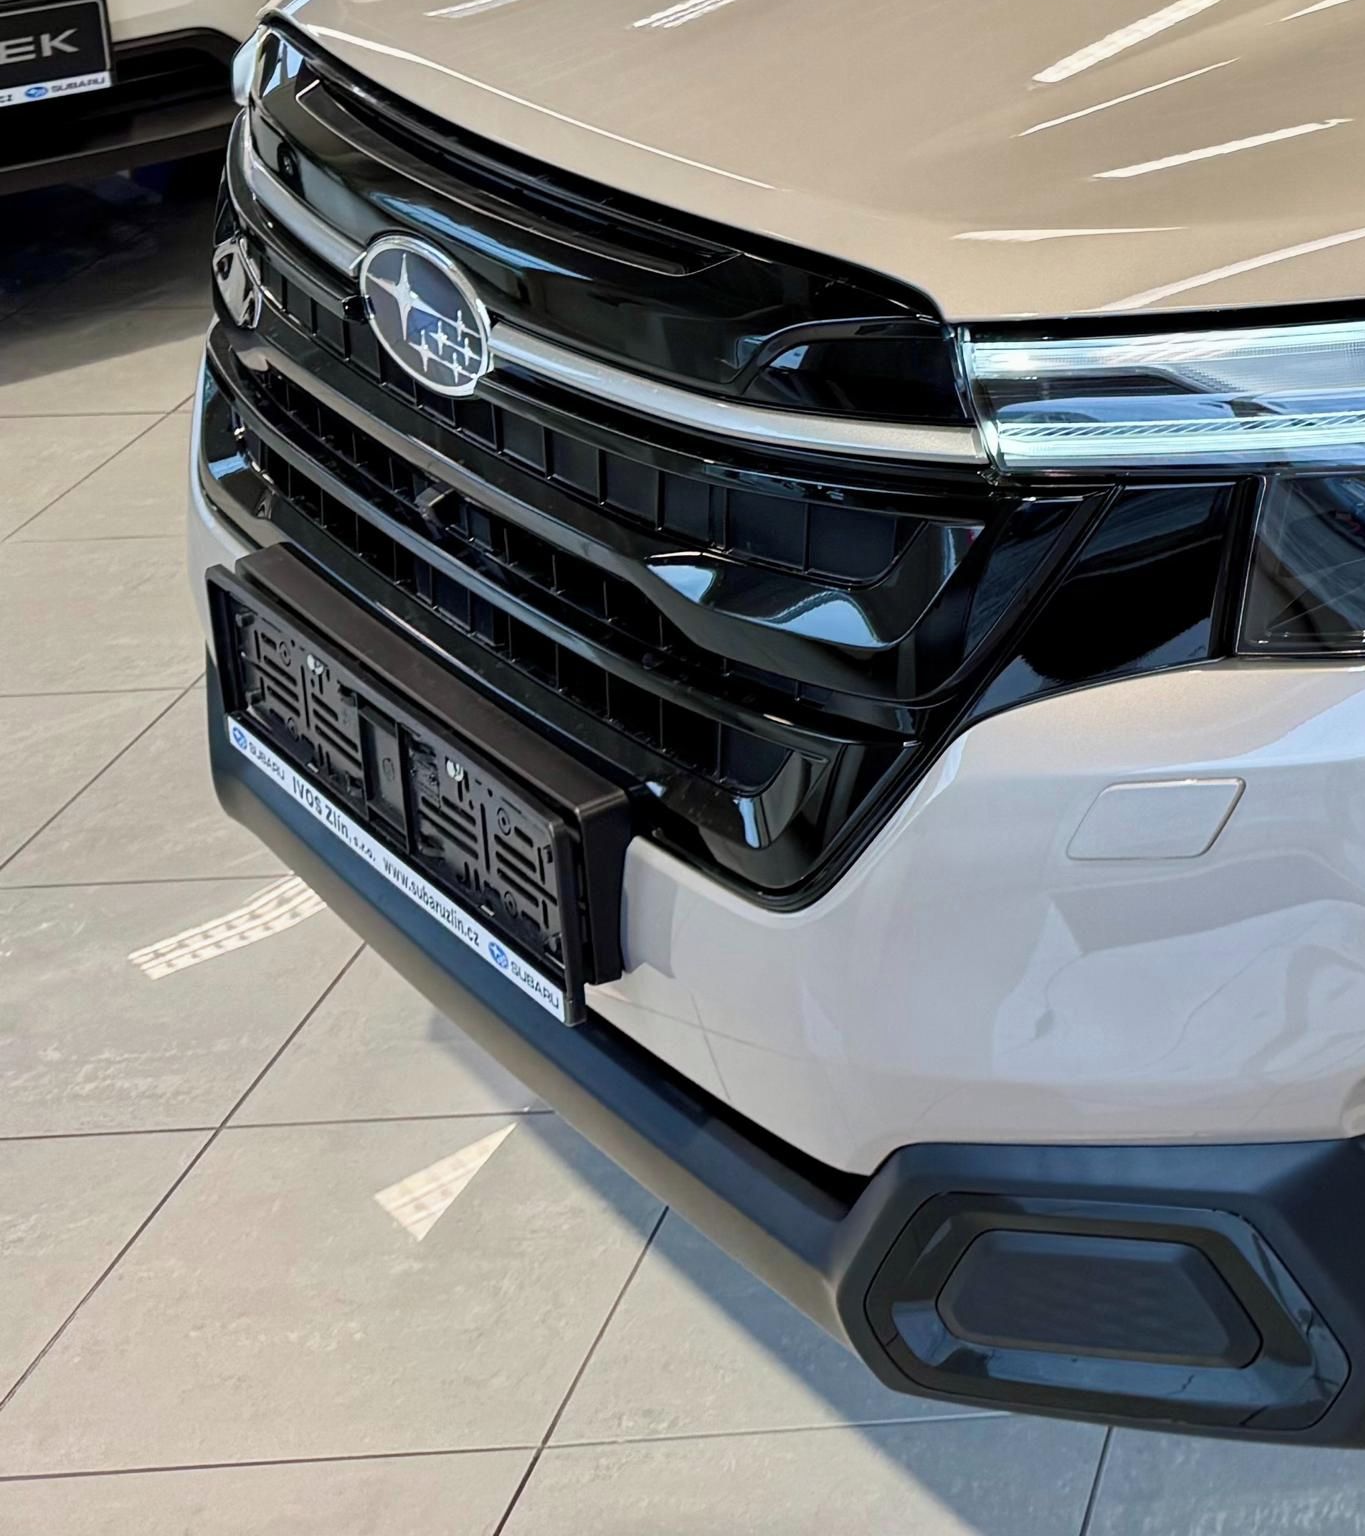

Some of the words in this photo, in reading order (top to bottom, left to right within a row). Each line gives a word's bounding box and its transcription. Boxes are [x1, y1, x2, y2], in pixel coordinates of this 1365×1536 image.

[50, 77, 106, 94] SUBARU
[248, 742, 285, 781] SUBARU
[292, 775, 323, 816] IVOS
[382, 857, 480, 947] www.subaruzlin.cz
[511, 960, 560, 1010] SUBARU
